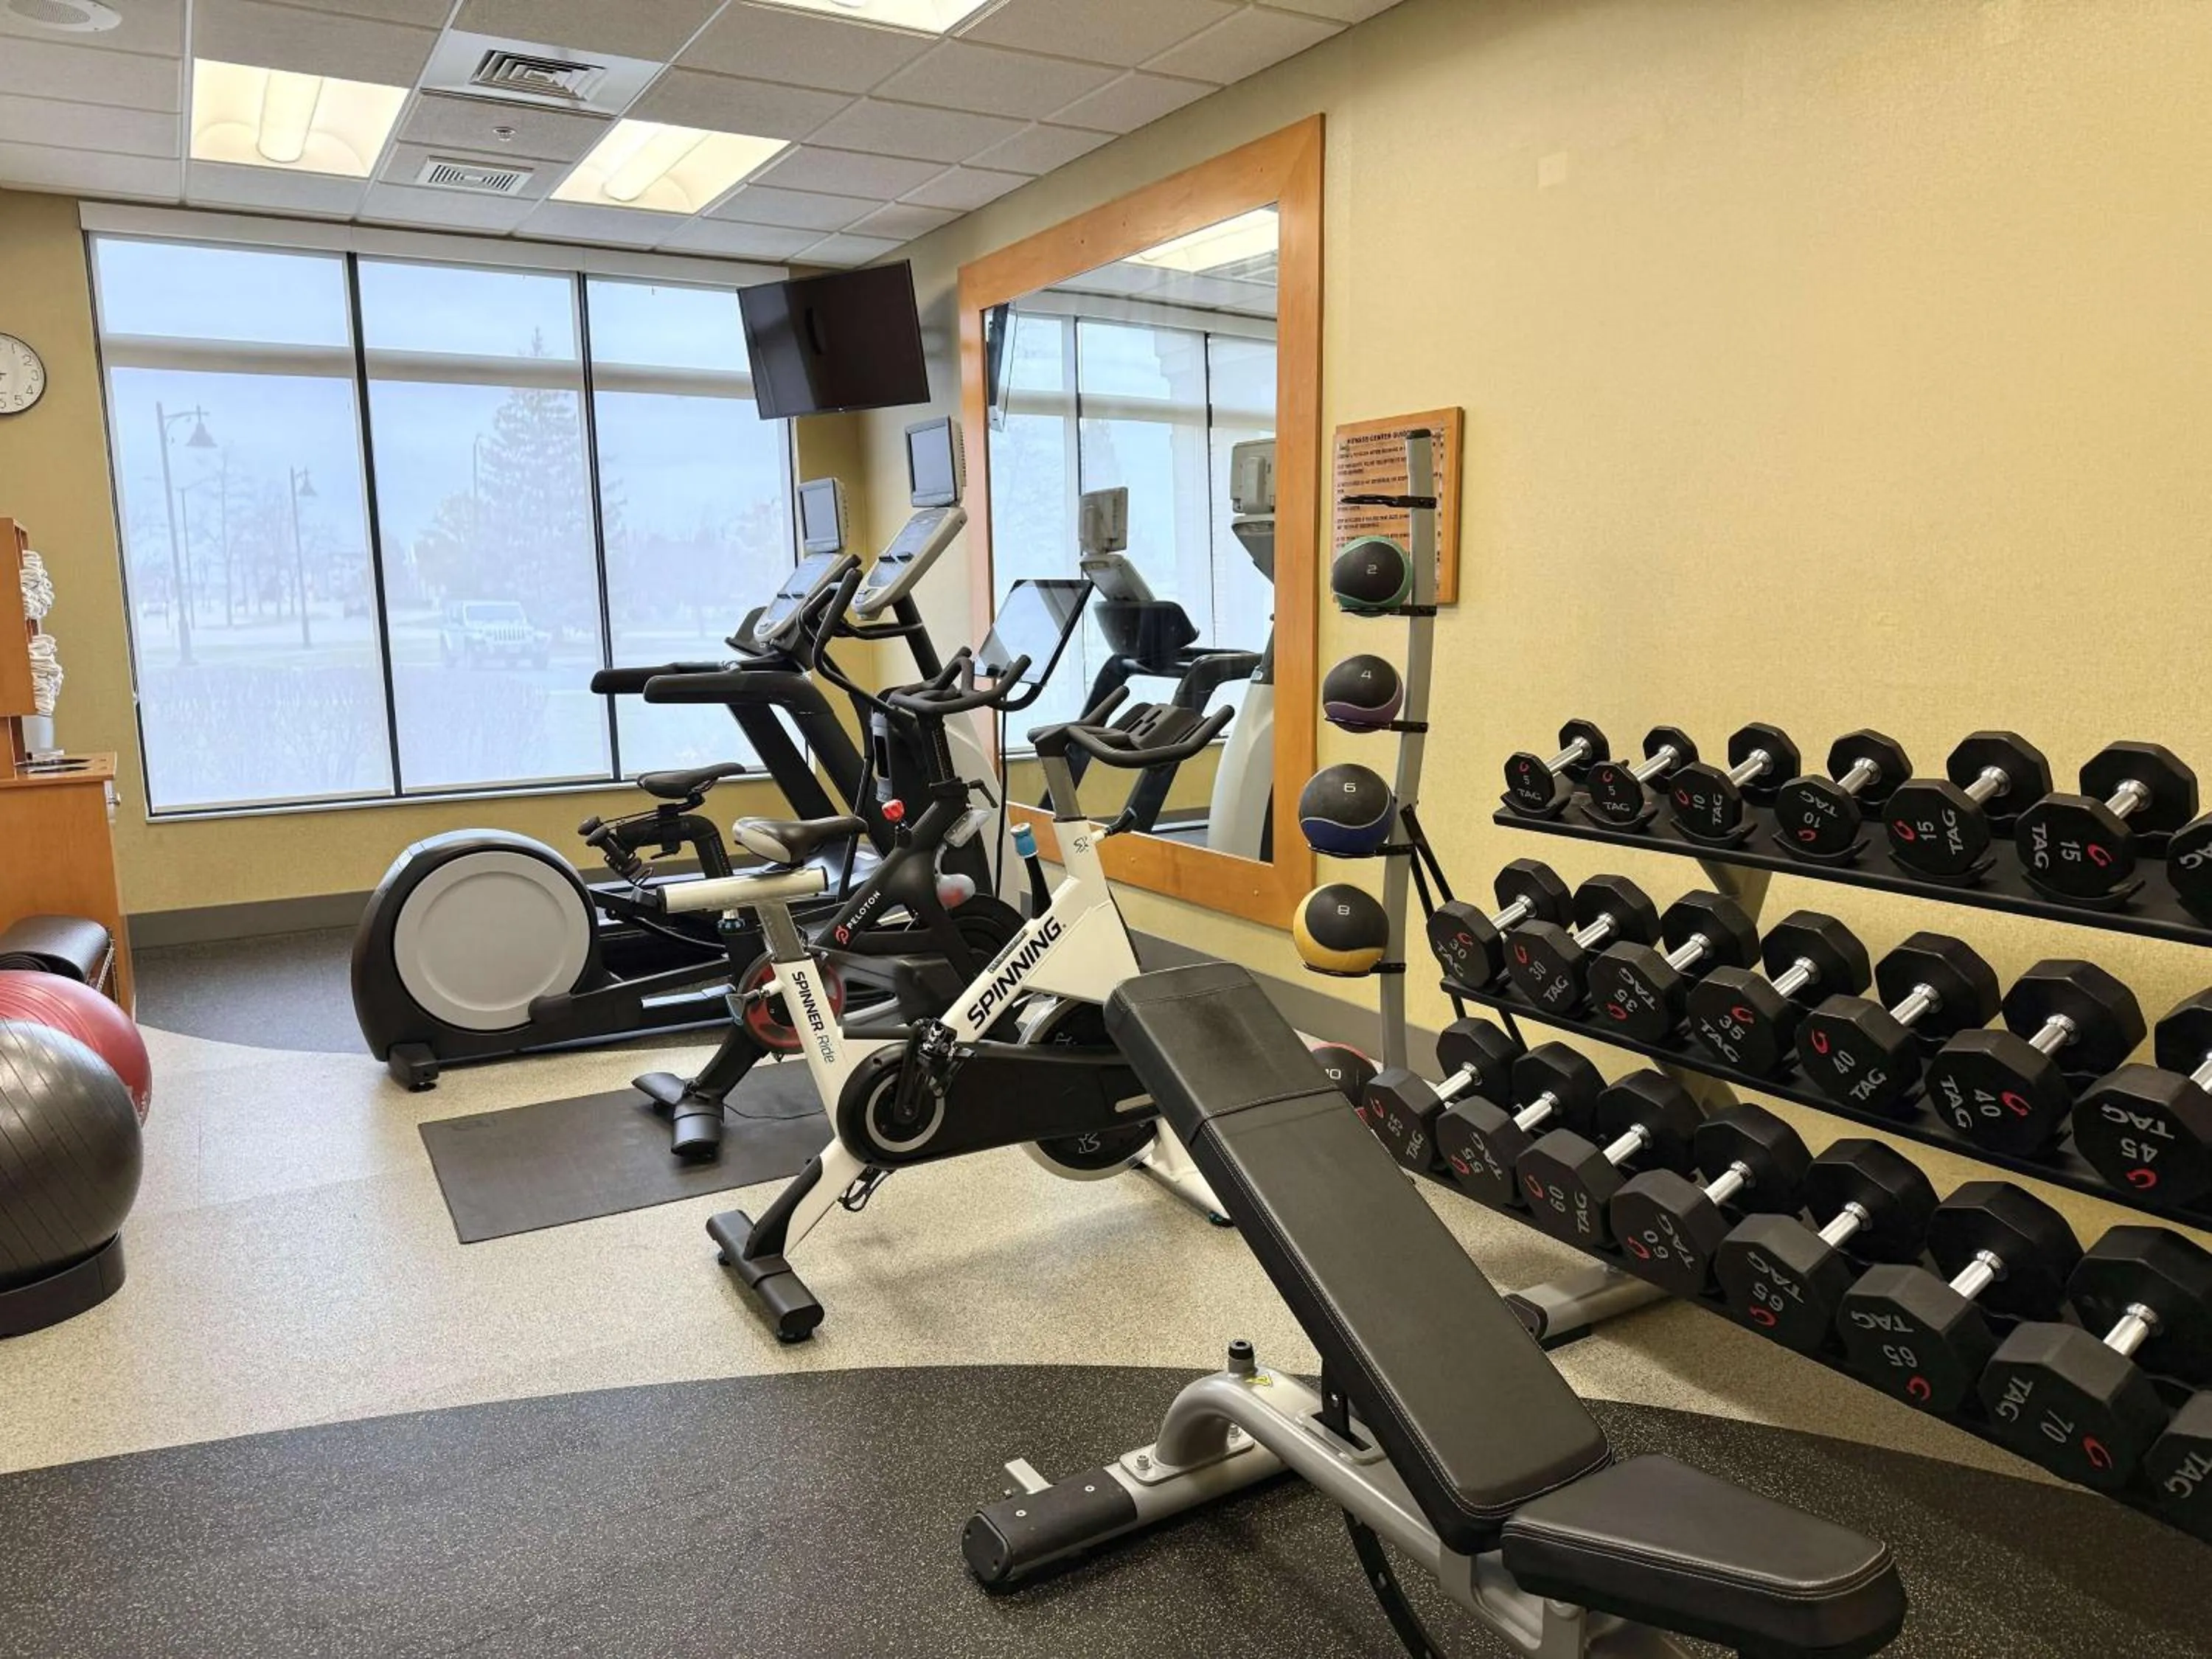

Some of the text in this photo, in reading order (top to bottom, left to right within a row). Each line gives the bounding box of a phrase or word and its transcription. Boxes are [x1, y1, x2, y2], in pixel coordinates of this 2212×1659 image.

[23, 354, 32, 366] 2
[30, 369, 38, 381] 3
[14, 394, 24, 406] 5
[26, 385, 33, 394] 4
[1367, 565, 1378, 574] 2
[1361, 670, 1371, 679] 4
[1343, 782, 1355, 793] 6
[1523, 775, 1530, 785] 5
[1608, 785, 1615, 796] 5
[1517, 788, 1542, 801] TAG
[1603, 801, 1630, 812] TAG
[1799, 790, 1838, 818] TAG
[1712, 793, 1723, 827] TAG
[1804, 812, 1820, 828] 10
[1917, 821, 1937, 841] 15
[1942, 809, 1964, 855] TAG
[2031, 822, 2049, 870] TAG
[2060, 841, 2081, 863] 15
[846, 891, 881, 930] PELOTON
[1338, 905, 1350, 915] 8
[1436, 940, 1464, 977] TAG
[1450, 942, 1467, 959] 30
[1529, 961, 1546, 981] 30
[1543, 975, 1568, 1003] TAG
[1614, 989, 1638, 1013] 35
[1618, 967, 1655, 1010] TAG
[1700, 1017, 1741, 1062] TAG
[1719, 1015, 1745, 1040] 35
[817, 1034, 835, 1064] Ride
[1832, 1049, 1856, 1074] 40
[1849, 1068, 1887, 1101] TAG
[1941, 1075, 1972, 1130] TAG
[1973, 1088, 2001, 1117] 40
[2102, 1104, 2174, 1139] TAG
[1405, 1130, 1425, 1160] TAG
[1470, 1132, 1503, 1180] TAG
[2121, 1138, 2158, 1163] 45
[1574, 1191, 1590, 1235] TAG
[1657, 1214, 1695, 1270] TAG
[1747, 1251, 1804, 1304] TAG
[1753, 1282, 1784, 1312] 65
[1851, 1310, 1916, 1334] TAG
[1882, 1344, 1917, 1368] 65
[1996, 1374, 2034, 1423] TAG
[2039, 1409, 2076, 1444] 70
[2163, 1451, 2212, 1499] TAG
